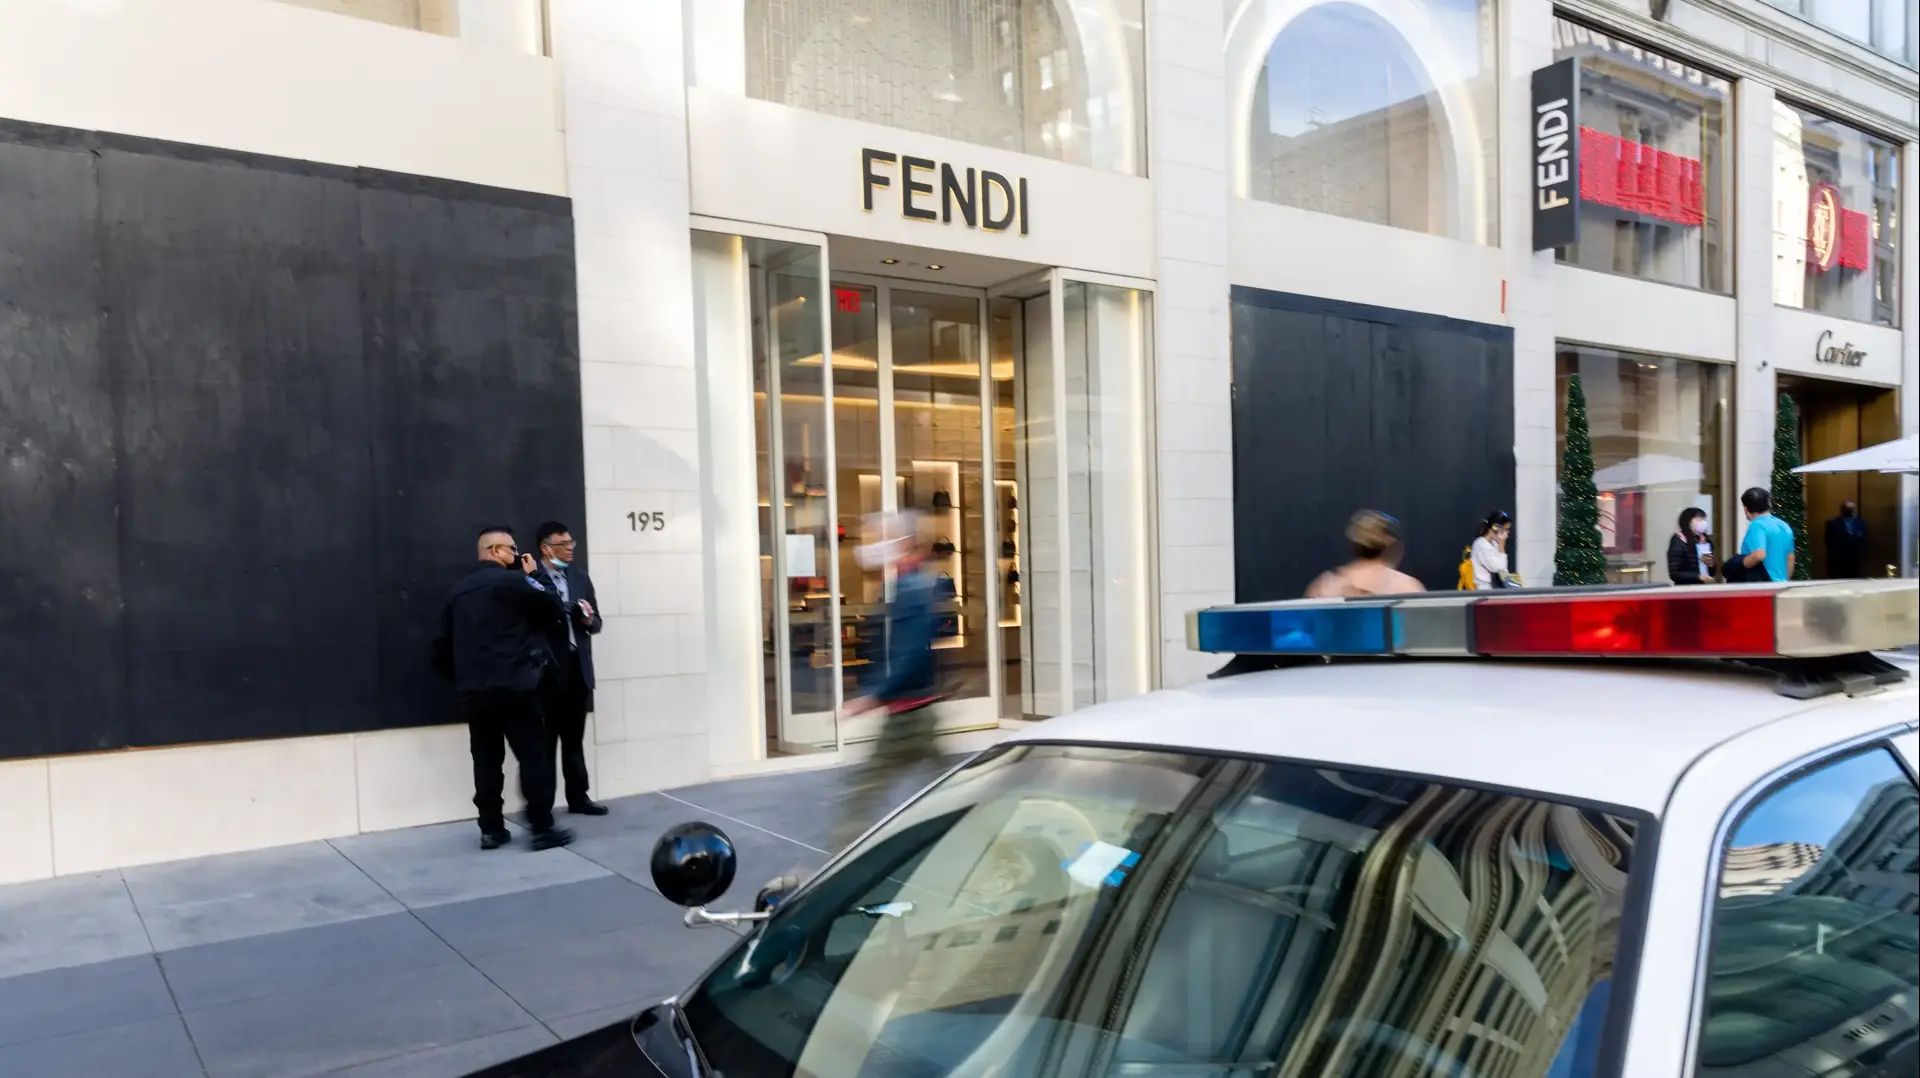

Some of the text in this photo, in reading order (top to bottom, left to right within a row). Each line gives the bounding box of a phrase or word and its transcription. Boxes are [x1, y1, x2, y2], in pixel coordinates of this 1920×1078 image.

[1537, 98, 1569, 210] FENDI
[861, 148, 1028, 237] FENDI
[1816, 329, 1868, 367] Cartier
[627, 511, 665, 532] 195
